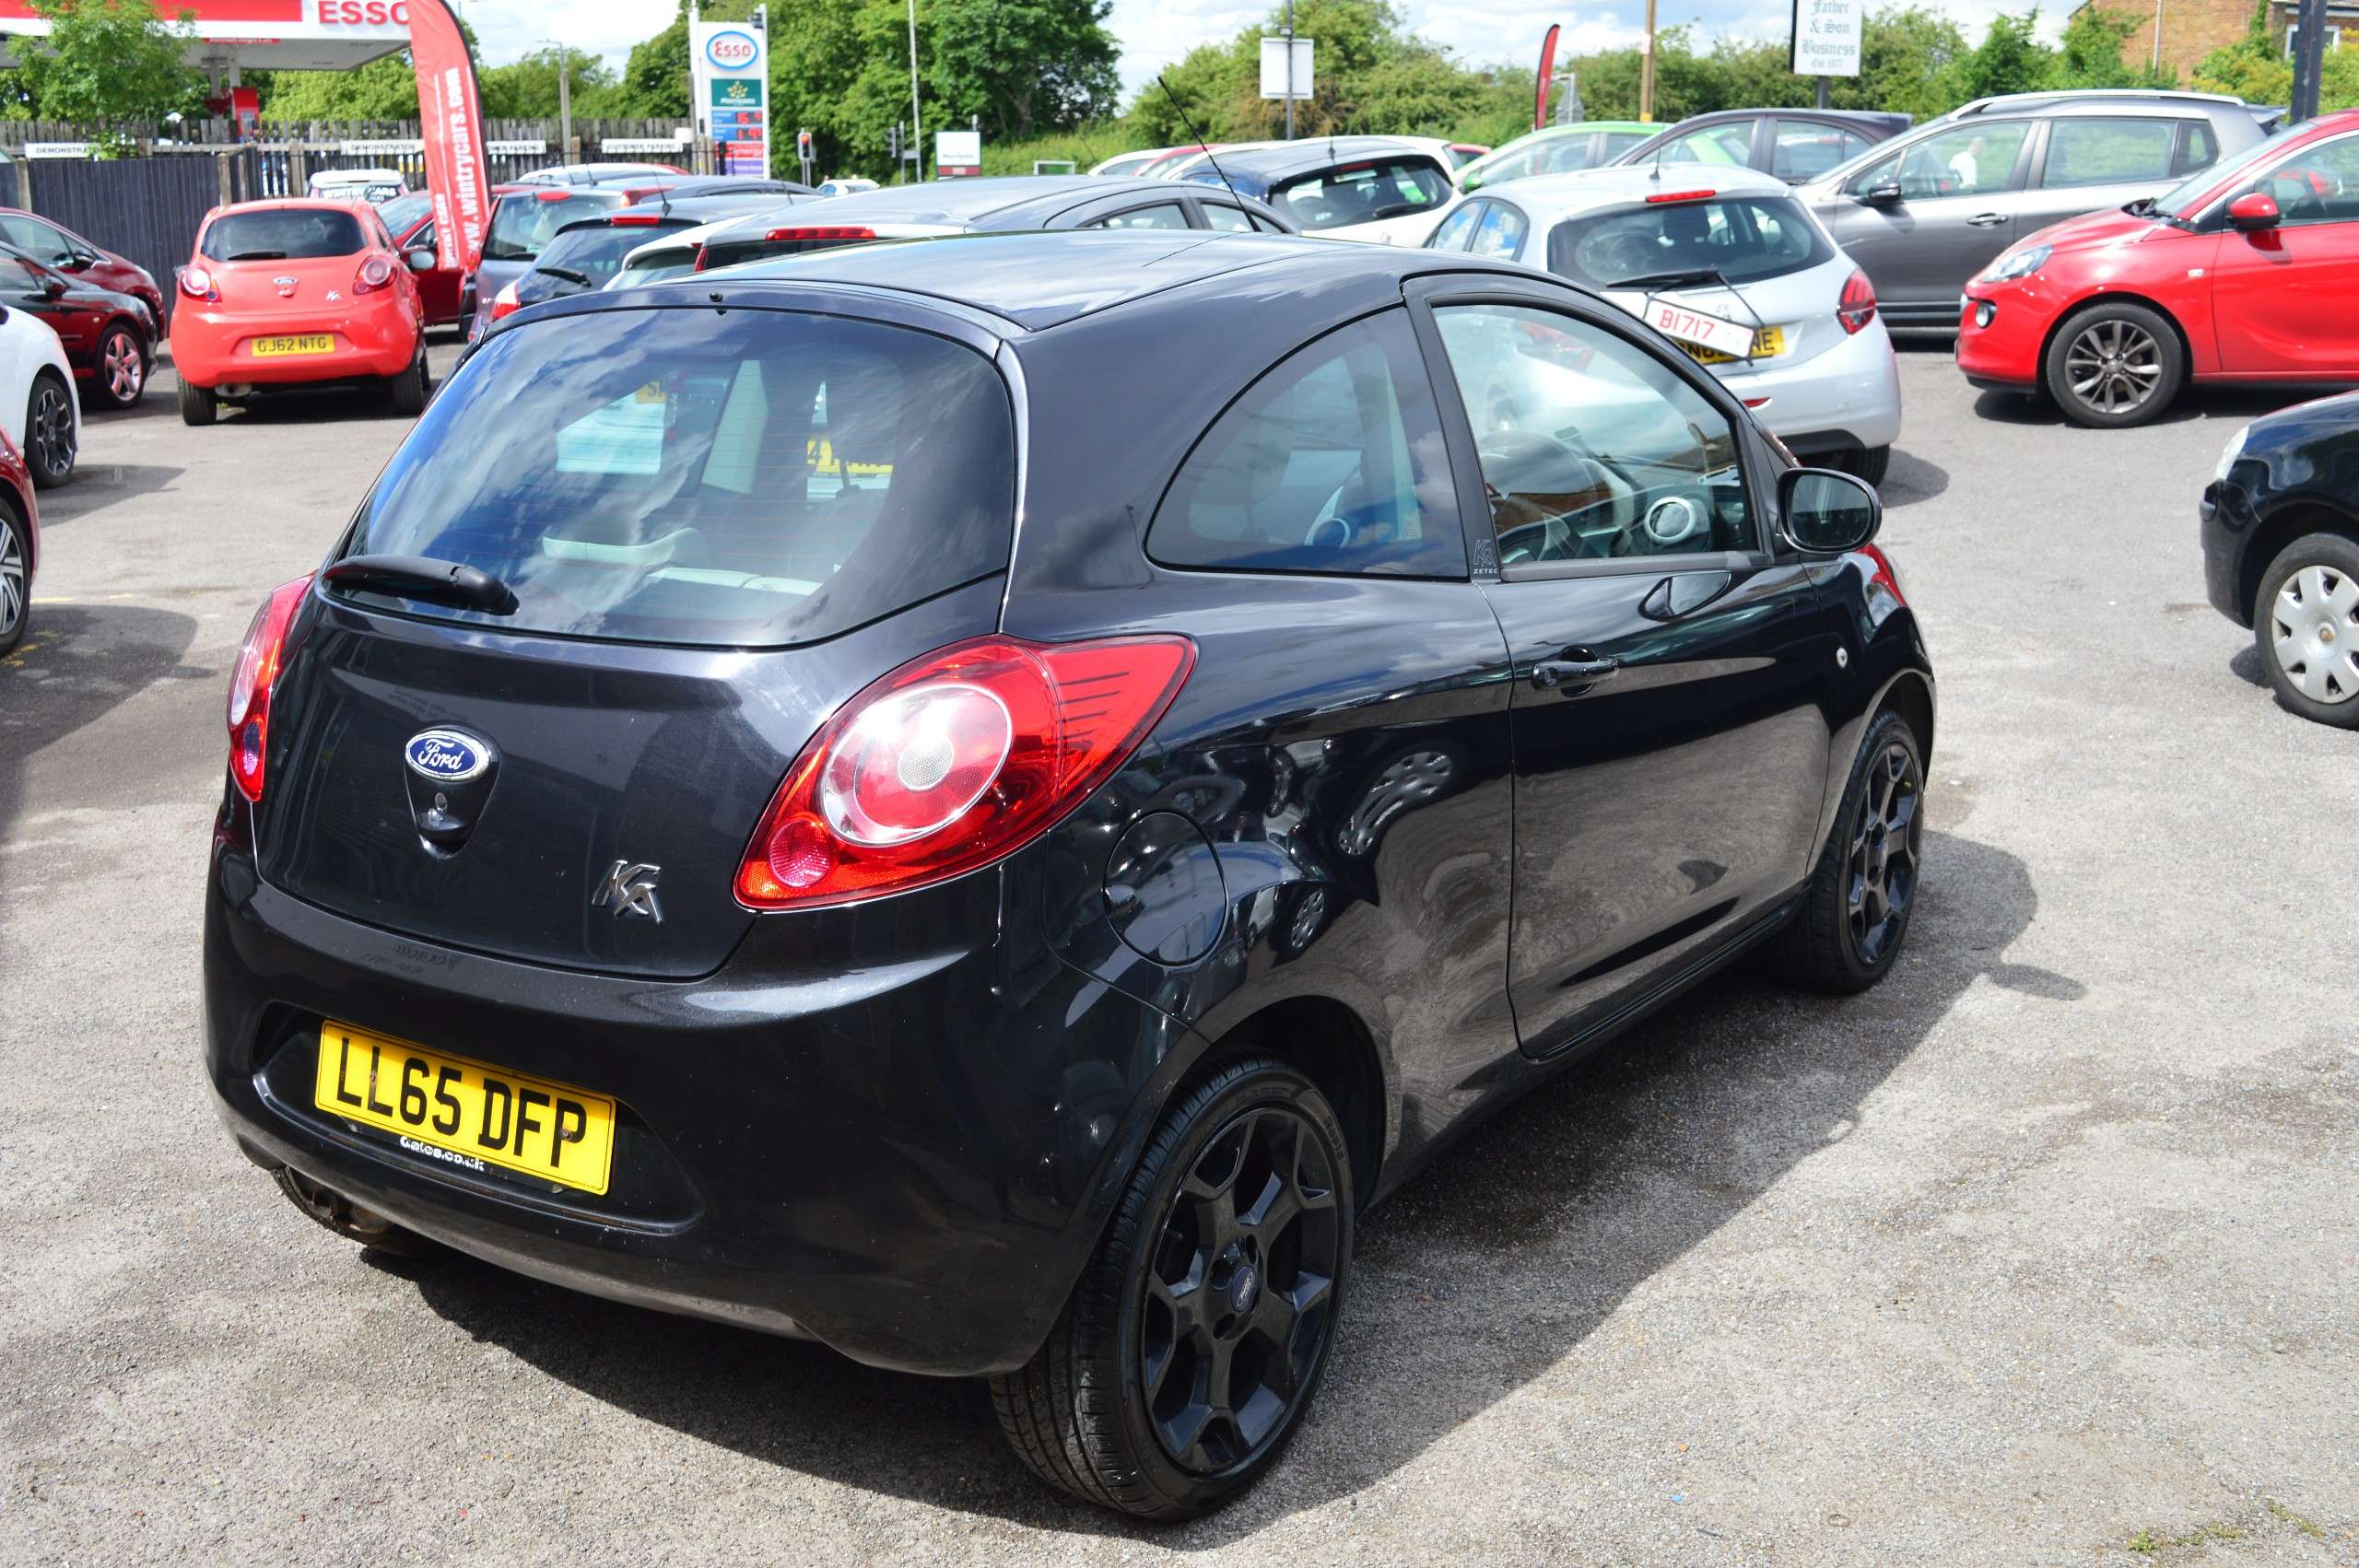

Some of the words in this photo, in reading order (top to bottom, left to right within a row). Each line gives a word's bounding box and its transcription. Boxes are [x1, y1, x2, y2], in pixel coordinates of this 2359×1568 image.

[318, 1, 411, 25] ESSO
[1825, 19, 1850, 33] Son
[1802, 39, 1856, 55] Business
[258, 338, 295, 353] GJ62
[299, 336, 327, 351] NTG
[417, 738, 464, 770] Ford
[337, 1037, 463, 1136] LL65
[477, 1078, 587, 1168] DFP
